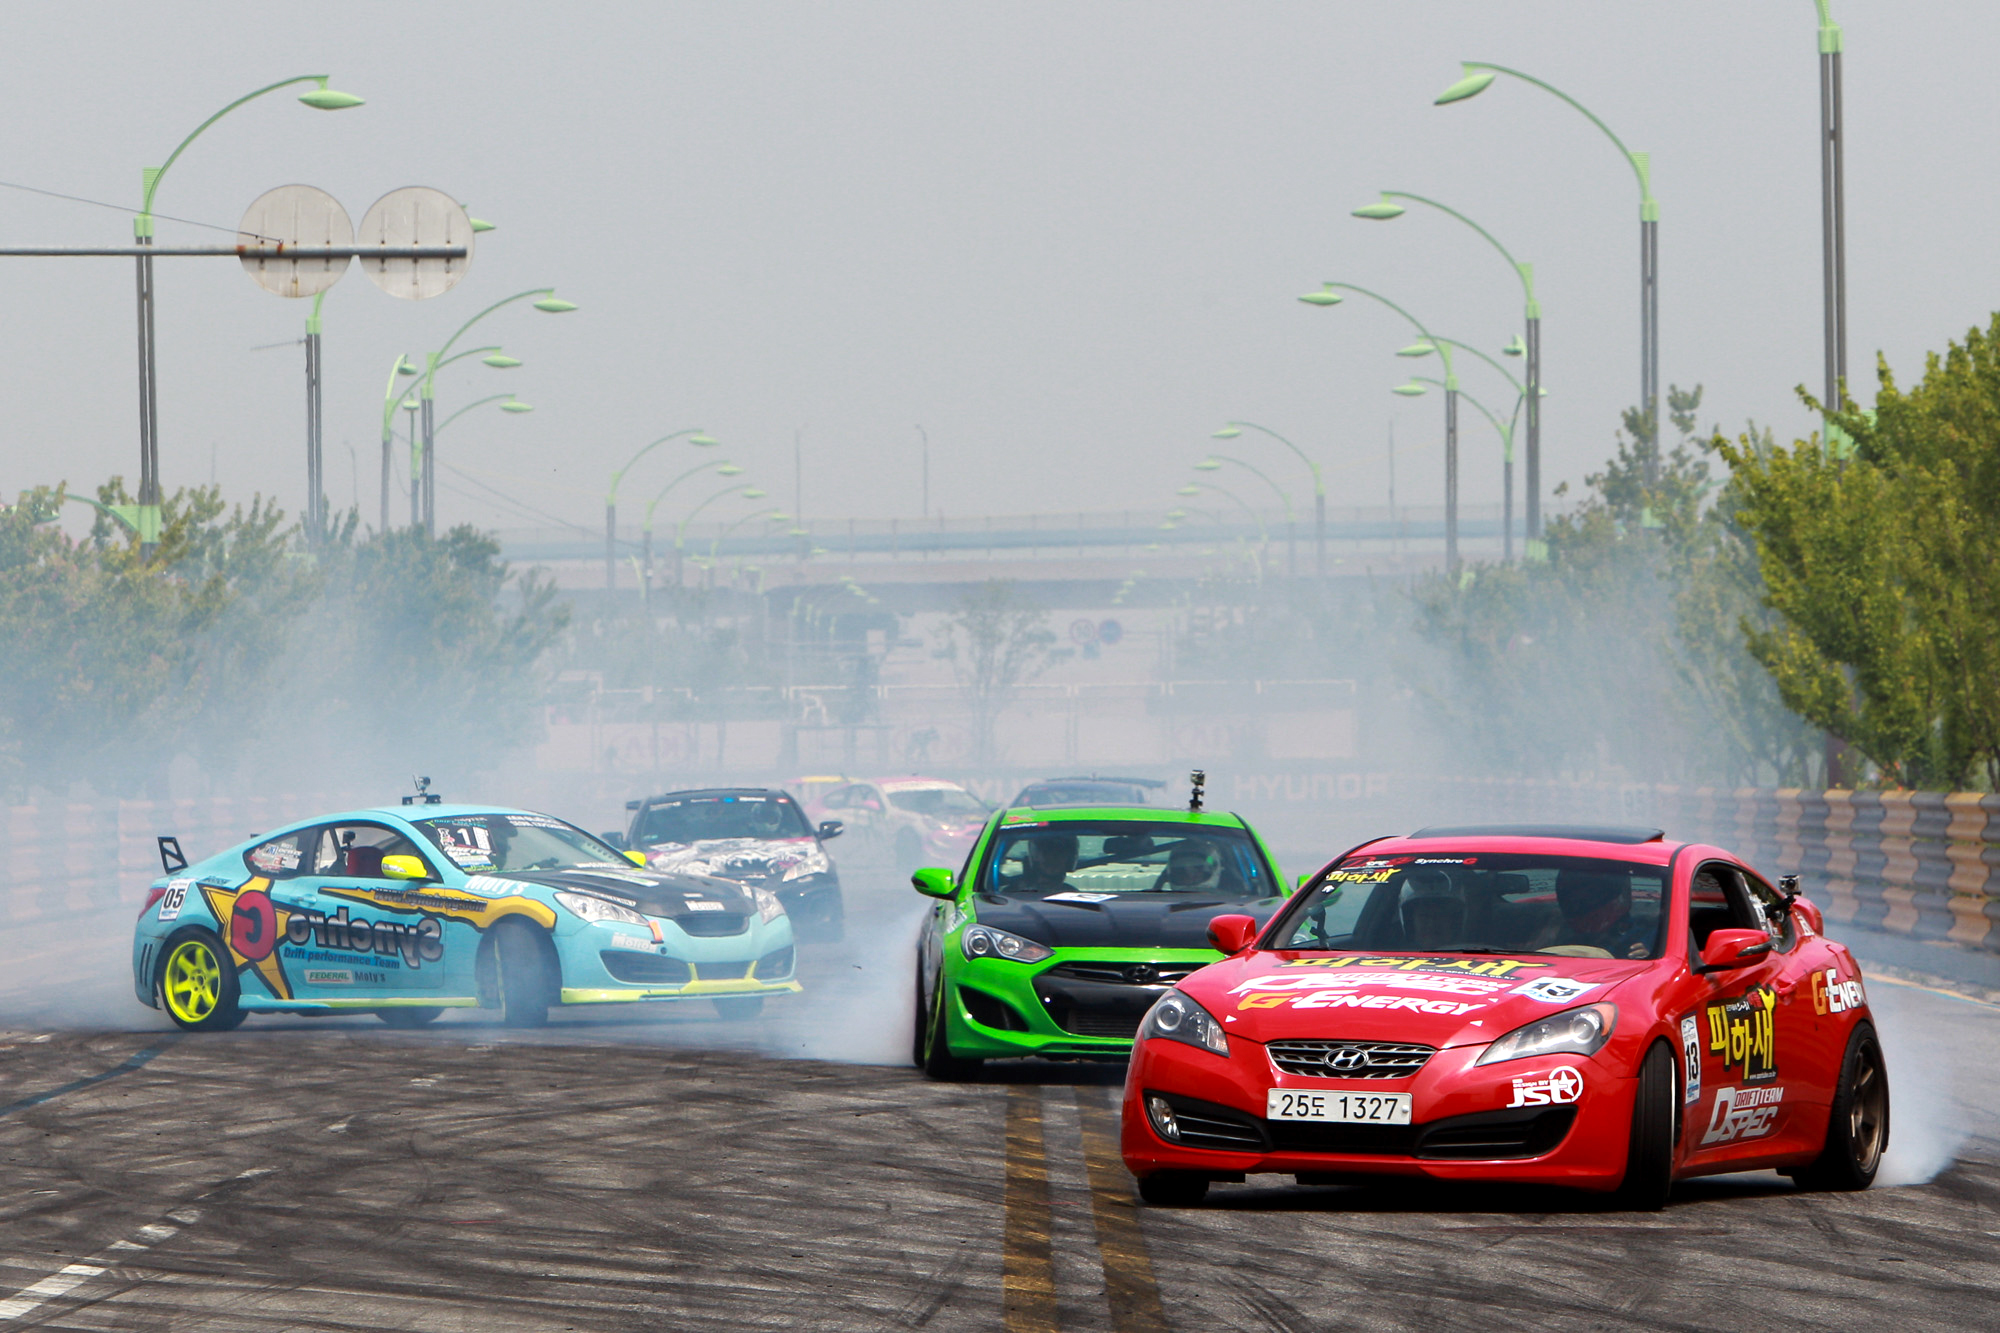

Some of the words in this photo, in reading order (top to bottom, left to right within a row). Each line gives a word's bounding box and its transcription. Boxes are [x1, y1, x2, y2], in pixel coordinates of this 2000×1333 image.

[1233, 773, 1390, 801] HYUNDA
[1414, 857, 1478, 866] SynchroG
[1327, 868, 1402, 884] 피하새
[163, 888, 186, 909] 05
[284, 947, 306, 960] Drift
[307, 950, 371, 965] performance
[374, 955, 400, 969] Team
[1280, 956, 1549, 976] 피하새
[309, 971, 350, 980] FEDERAL
[1531, 982, 1581, 997] 13
[1707, 988, 1776, 1080] 피하새
[1685, 1041, 1699, 1081] 13
[1280, 1093, 1325, 1117] 25도
[1339, 1096, 1399, 1120] 1327
[1735, 1089, 1761, 1108] DRIFT
[1760, 1087, 1784, 1104] TEAM
